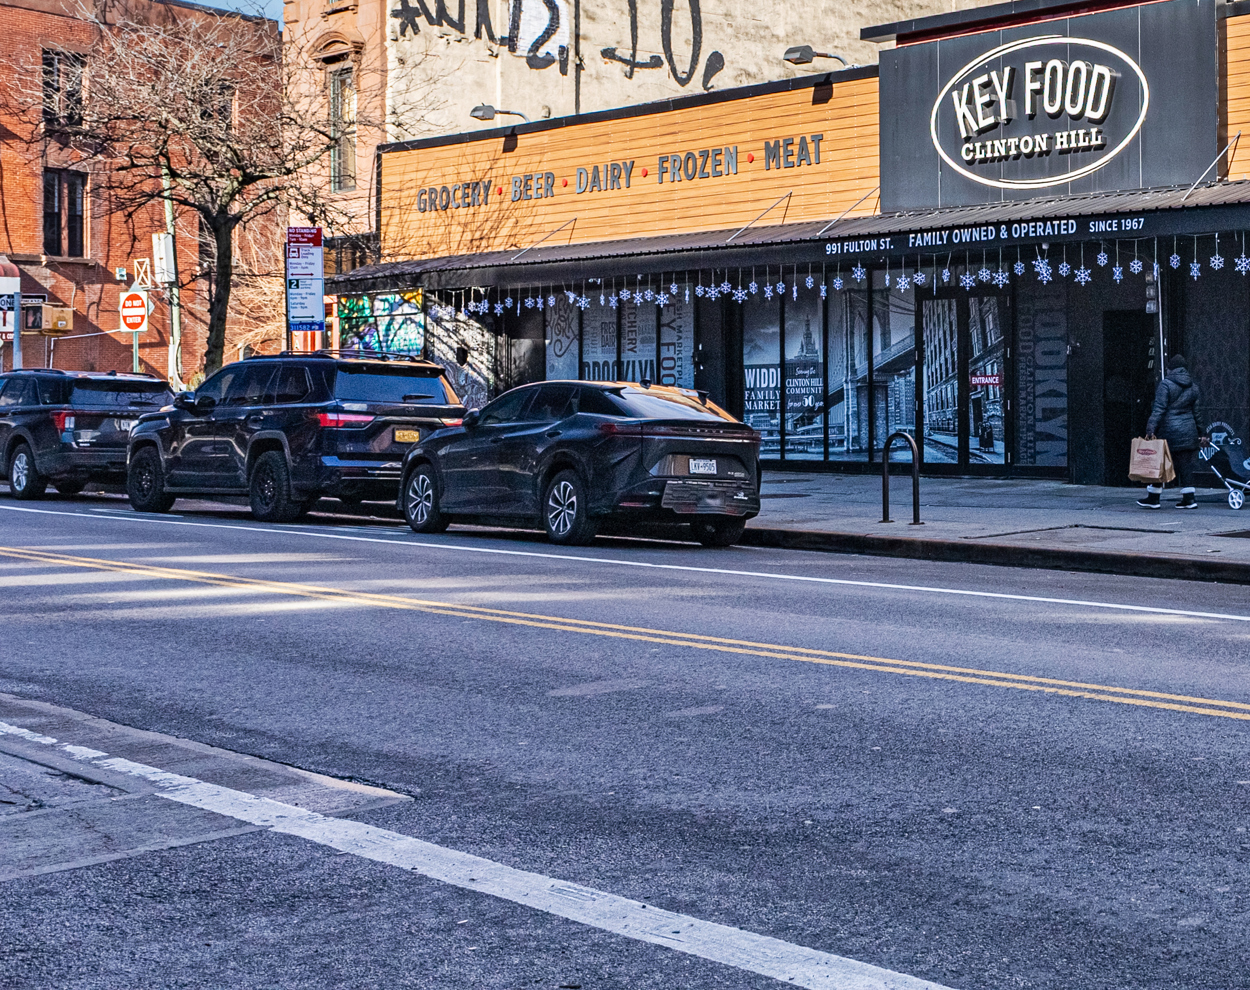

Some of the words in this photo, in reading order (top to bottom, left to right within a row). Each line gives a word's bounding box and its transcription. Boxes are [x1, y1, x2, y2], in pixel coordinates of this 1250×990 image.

[951, 66, 1015, 140] KEY
[1024, 58, 1114, 122] FOOD
[960, 132, 1049, 161] CLINTON
[1054, 127, 1104, 150] HILL
[416, 178, 493, 214] GROCERY
[511, 170, 556, 203] BEER
[575, 159, 636, 195] DAIRY
[657, 144, 739, 185] FROZEN
[763, 133, 824, 171] MEAT
[825, 242, 841, 255] 991
[843, 239, 878, 254] FULTON
[879, 238, 894, 251] ST.
[908, 229, 948, 248] FAMILY
[952, 225, 996, 244] OWNED
[999, 223, 1008, 239] &
[1011, 218, 1077, 239] OPERATED
[1088, 218, 1118, 233] SINCE
[1120, 217, 1145, 231] 1967
[291, 280, 298, 289] 2
[785, 379, 810, 387] CLINTON
[810, 378, 823, 387] HILL
[971, 376, 1000, 384] ENTRANCE
[744, 390, 780, 400] FAMILY
[785, 387, 823, 395] COMMUNIT
[744, 400, 780, 410] MARKET
[801, 395, 815, 407] 50
[1198, 446, 1219, 460] DAIR
